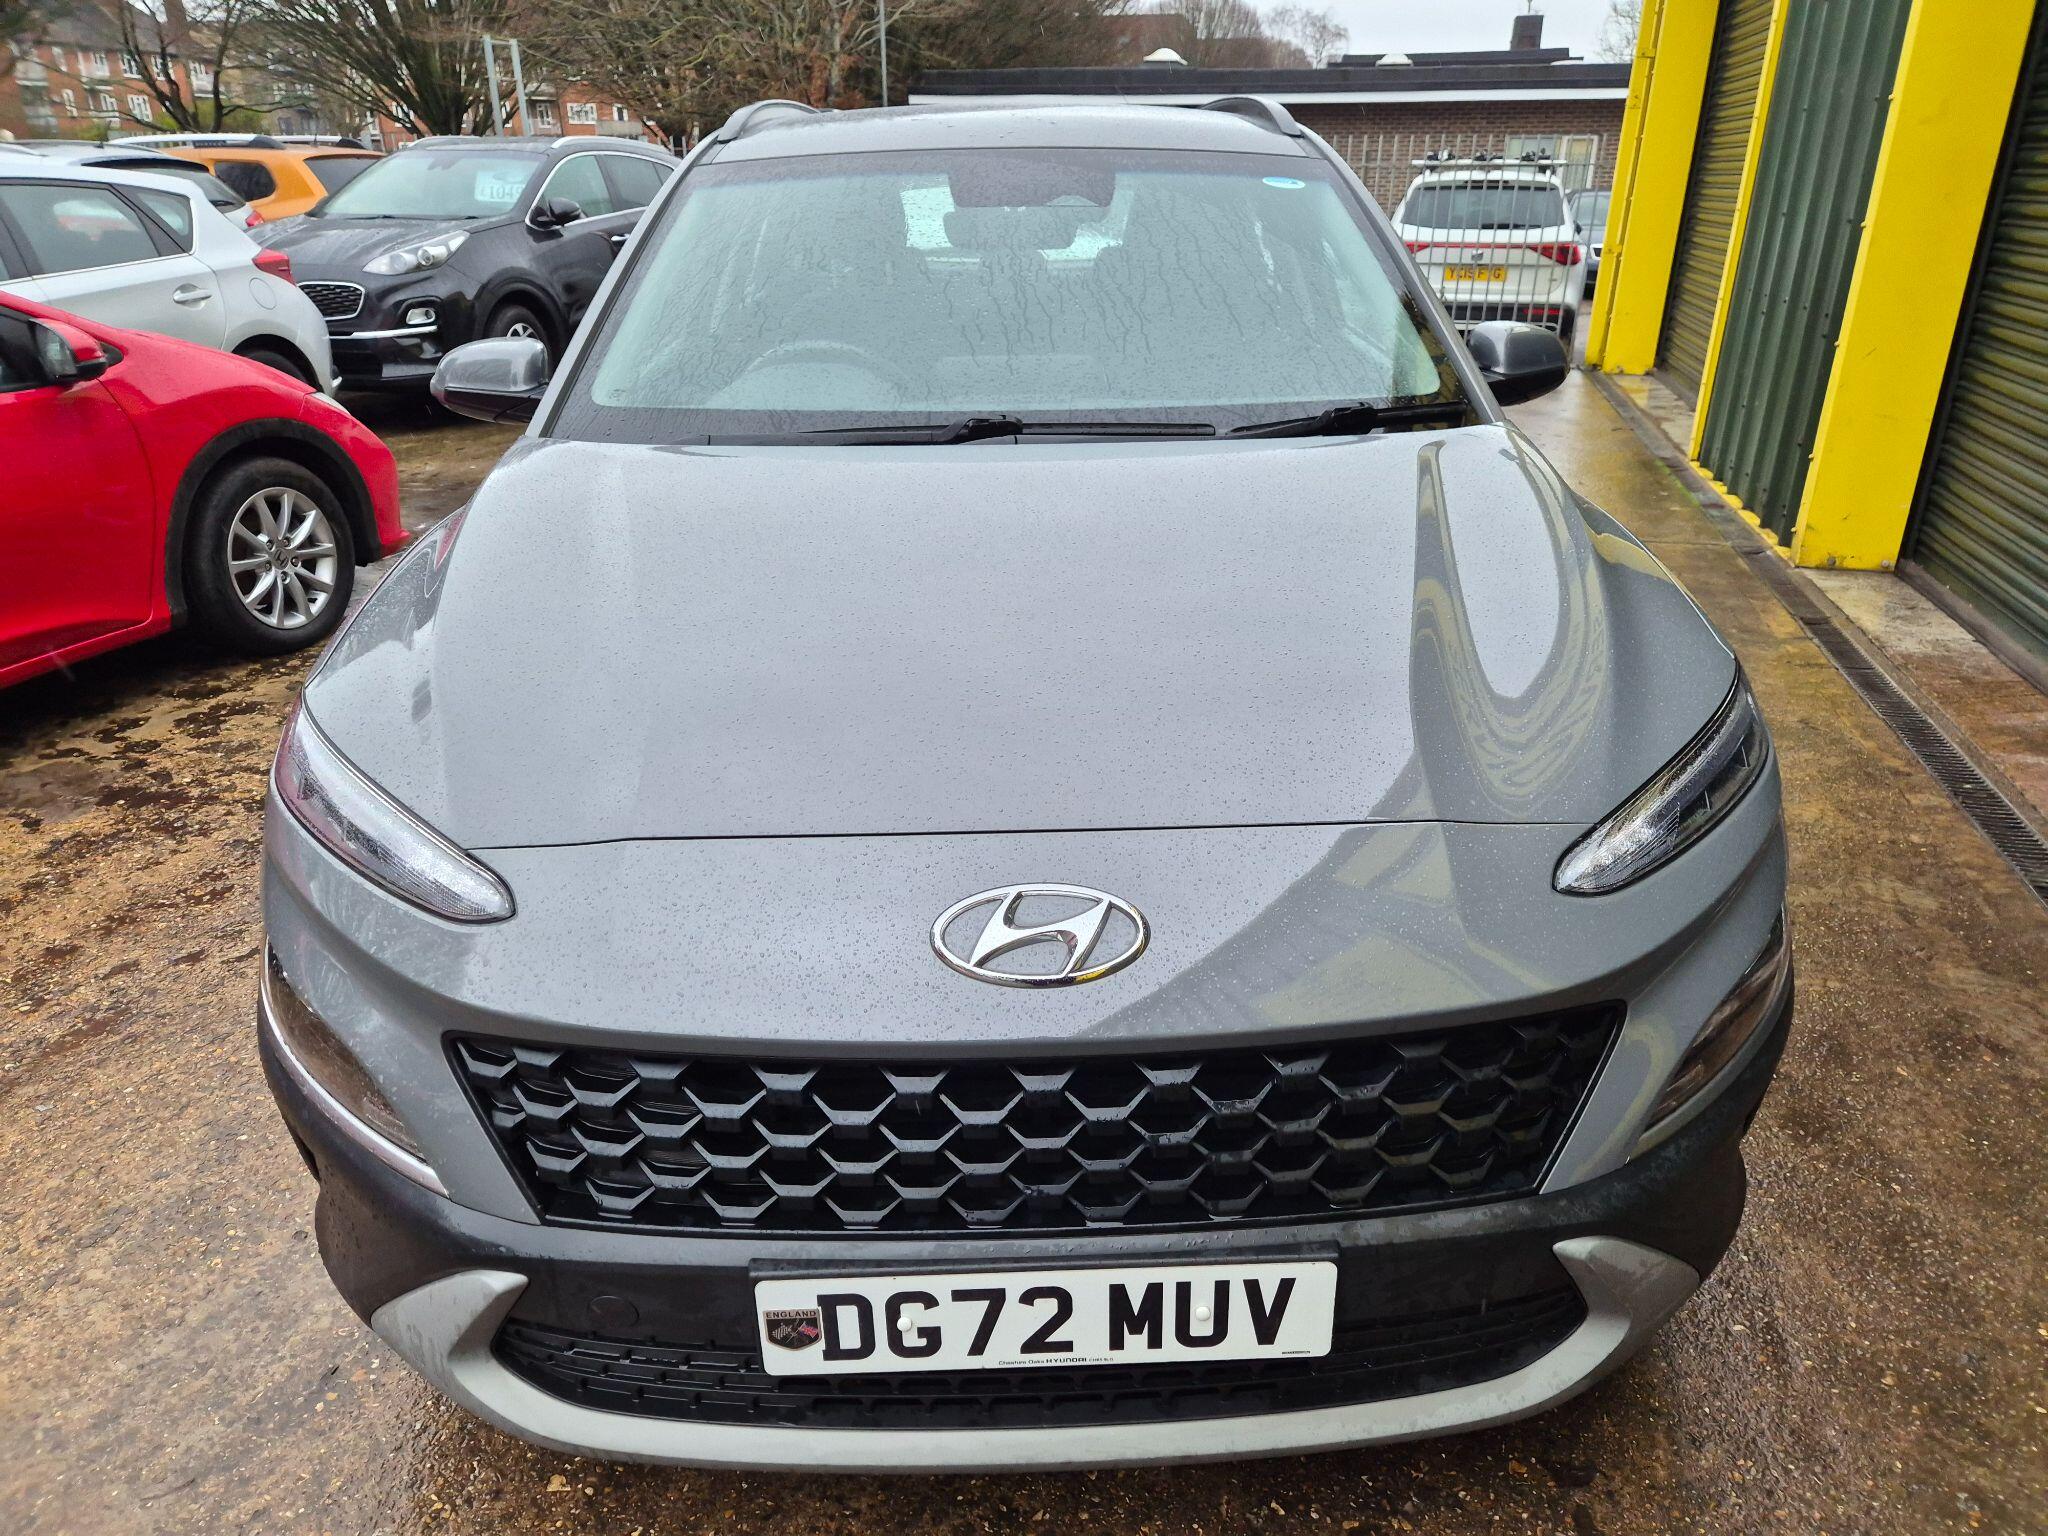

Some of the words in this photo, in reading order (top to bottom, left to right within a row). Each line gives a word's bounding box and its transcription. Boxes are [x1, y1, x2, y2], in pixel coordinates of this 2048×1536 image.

[765, 1310, 817, 1319] ENGLAND
[817, 1285, 1074, 1361] DG72
[1109, 1277, 1297, 1352] MUV
